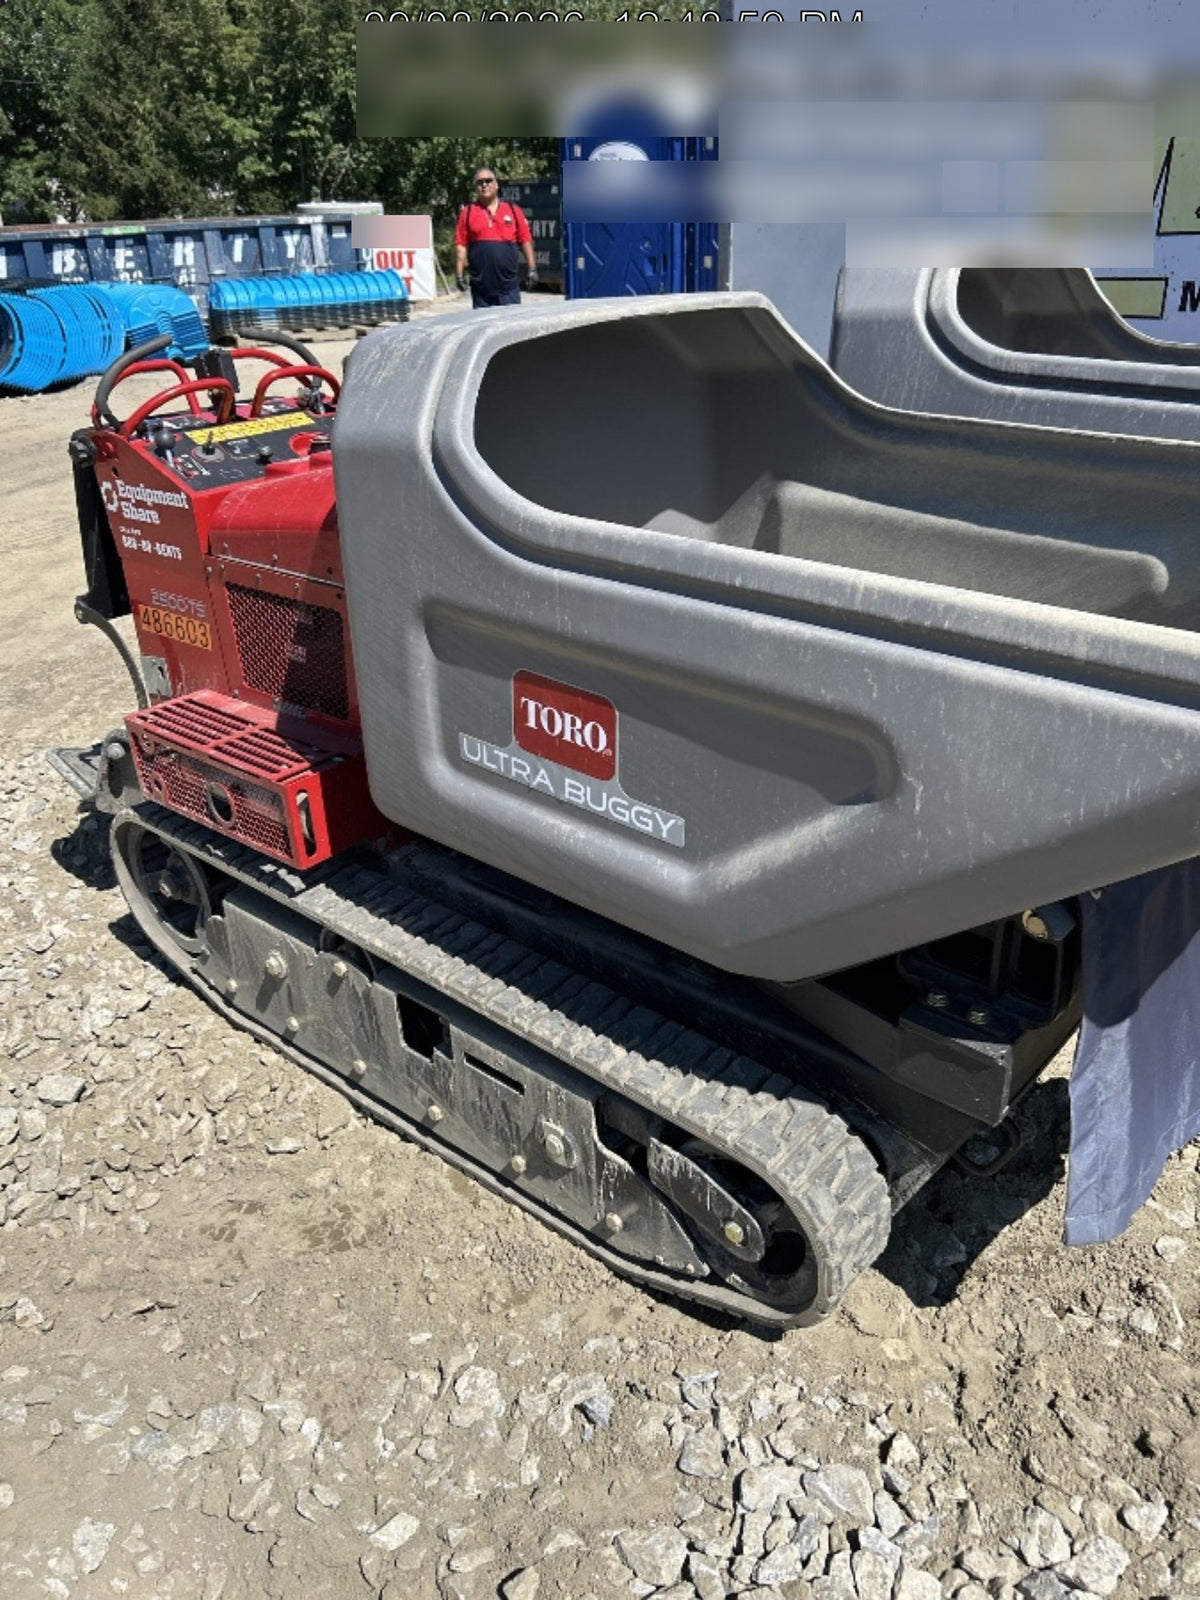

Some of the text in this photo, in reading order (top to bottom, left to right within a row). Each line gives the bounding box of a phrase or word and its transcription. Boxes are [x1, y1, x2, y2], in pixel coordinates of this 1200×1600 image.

[376, 250, 415, 270] OUT
[115, 479, 189, 509] Equipment
[121, 500, 160, 524] Share
[142, 607, 209, 648] 486603
[520, 696, 608, 753] TORO
[462, 737, 677, 839] ULTRA BUGGY
